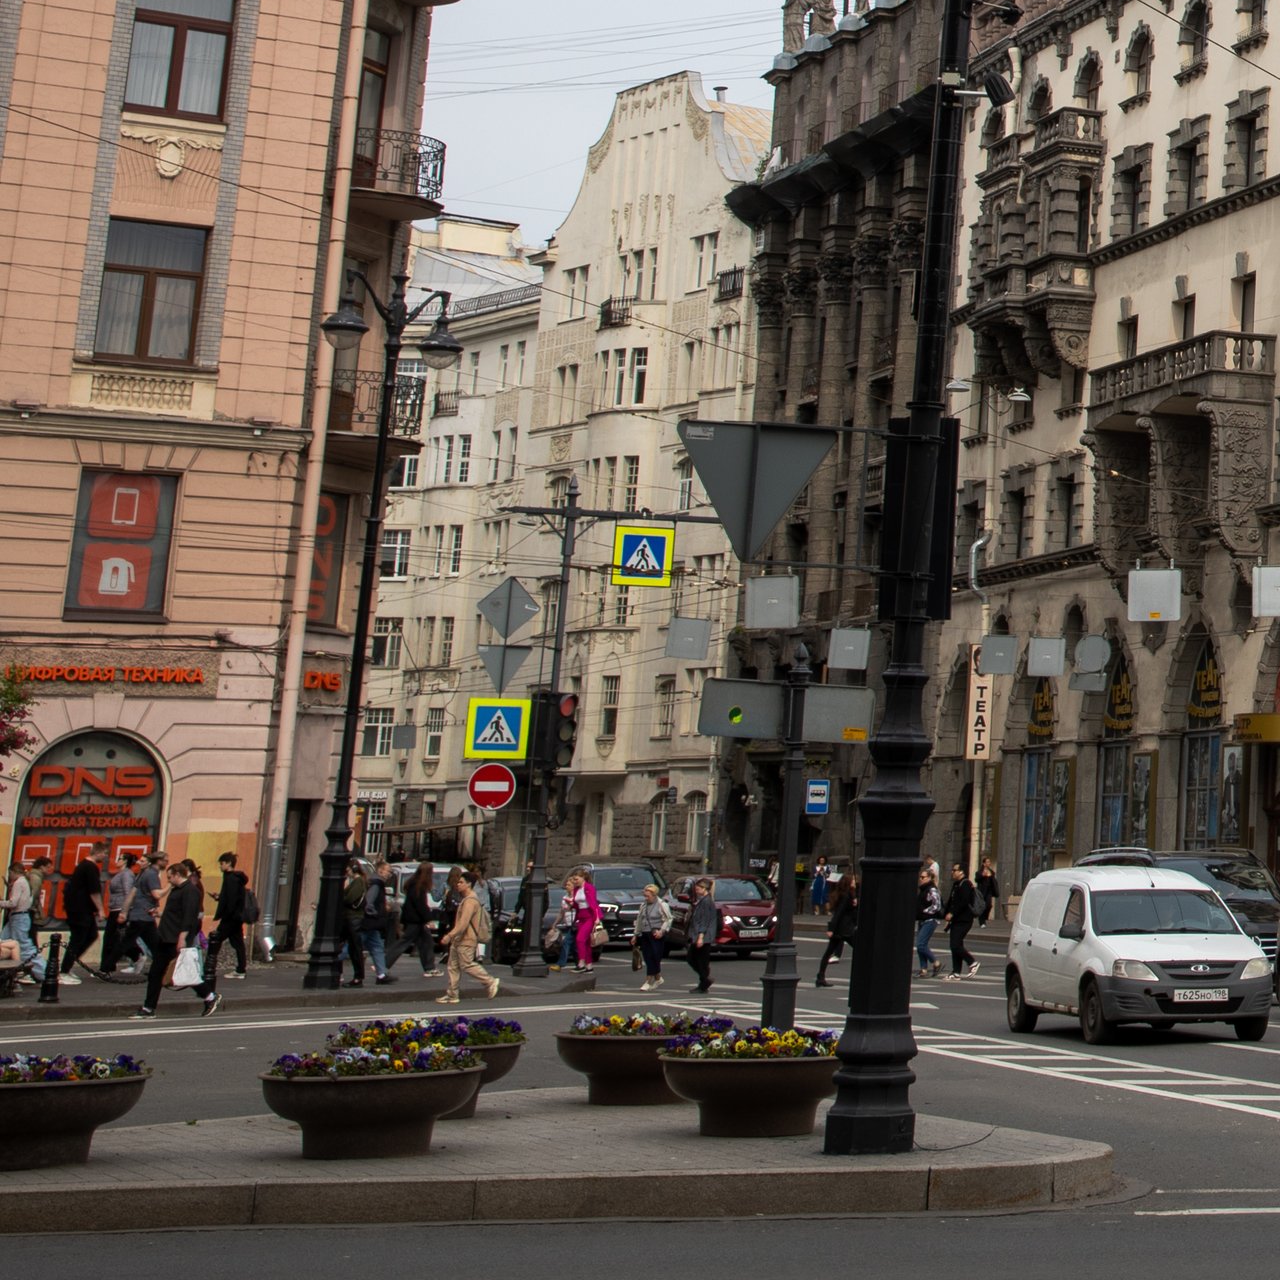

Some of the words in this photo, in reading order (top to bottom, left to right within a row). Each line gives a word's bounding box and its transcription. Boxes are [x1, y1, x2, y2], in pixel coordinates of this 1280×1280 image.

[123, 666, 204, 685] ТЕХНИКА
[304, 671, 342, 692] DNS
[974, 686, 988, 756] ТЕАТР
[28, 765, 156, 798] DNS
[44, 803, 119, 816] ЦИФРОВАЯ
[122, 803, 133, 815] И
[23, 816, 87, 829] БЫТОВАЯ
[88, 816, 149, 828] ТЕХНИКА
